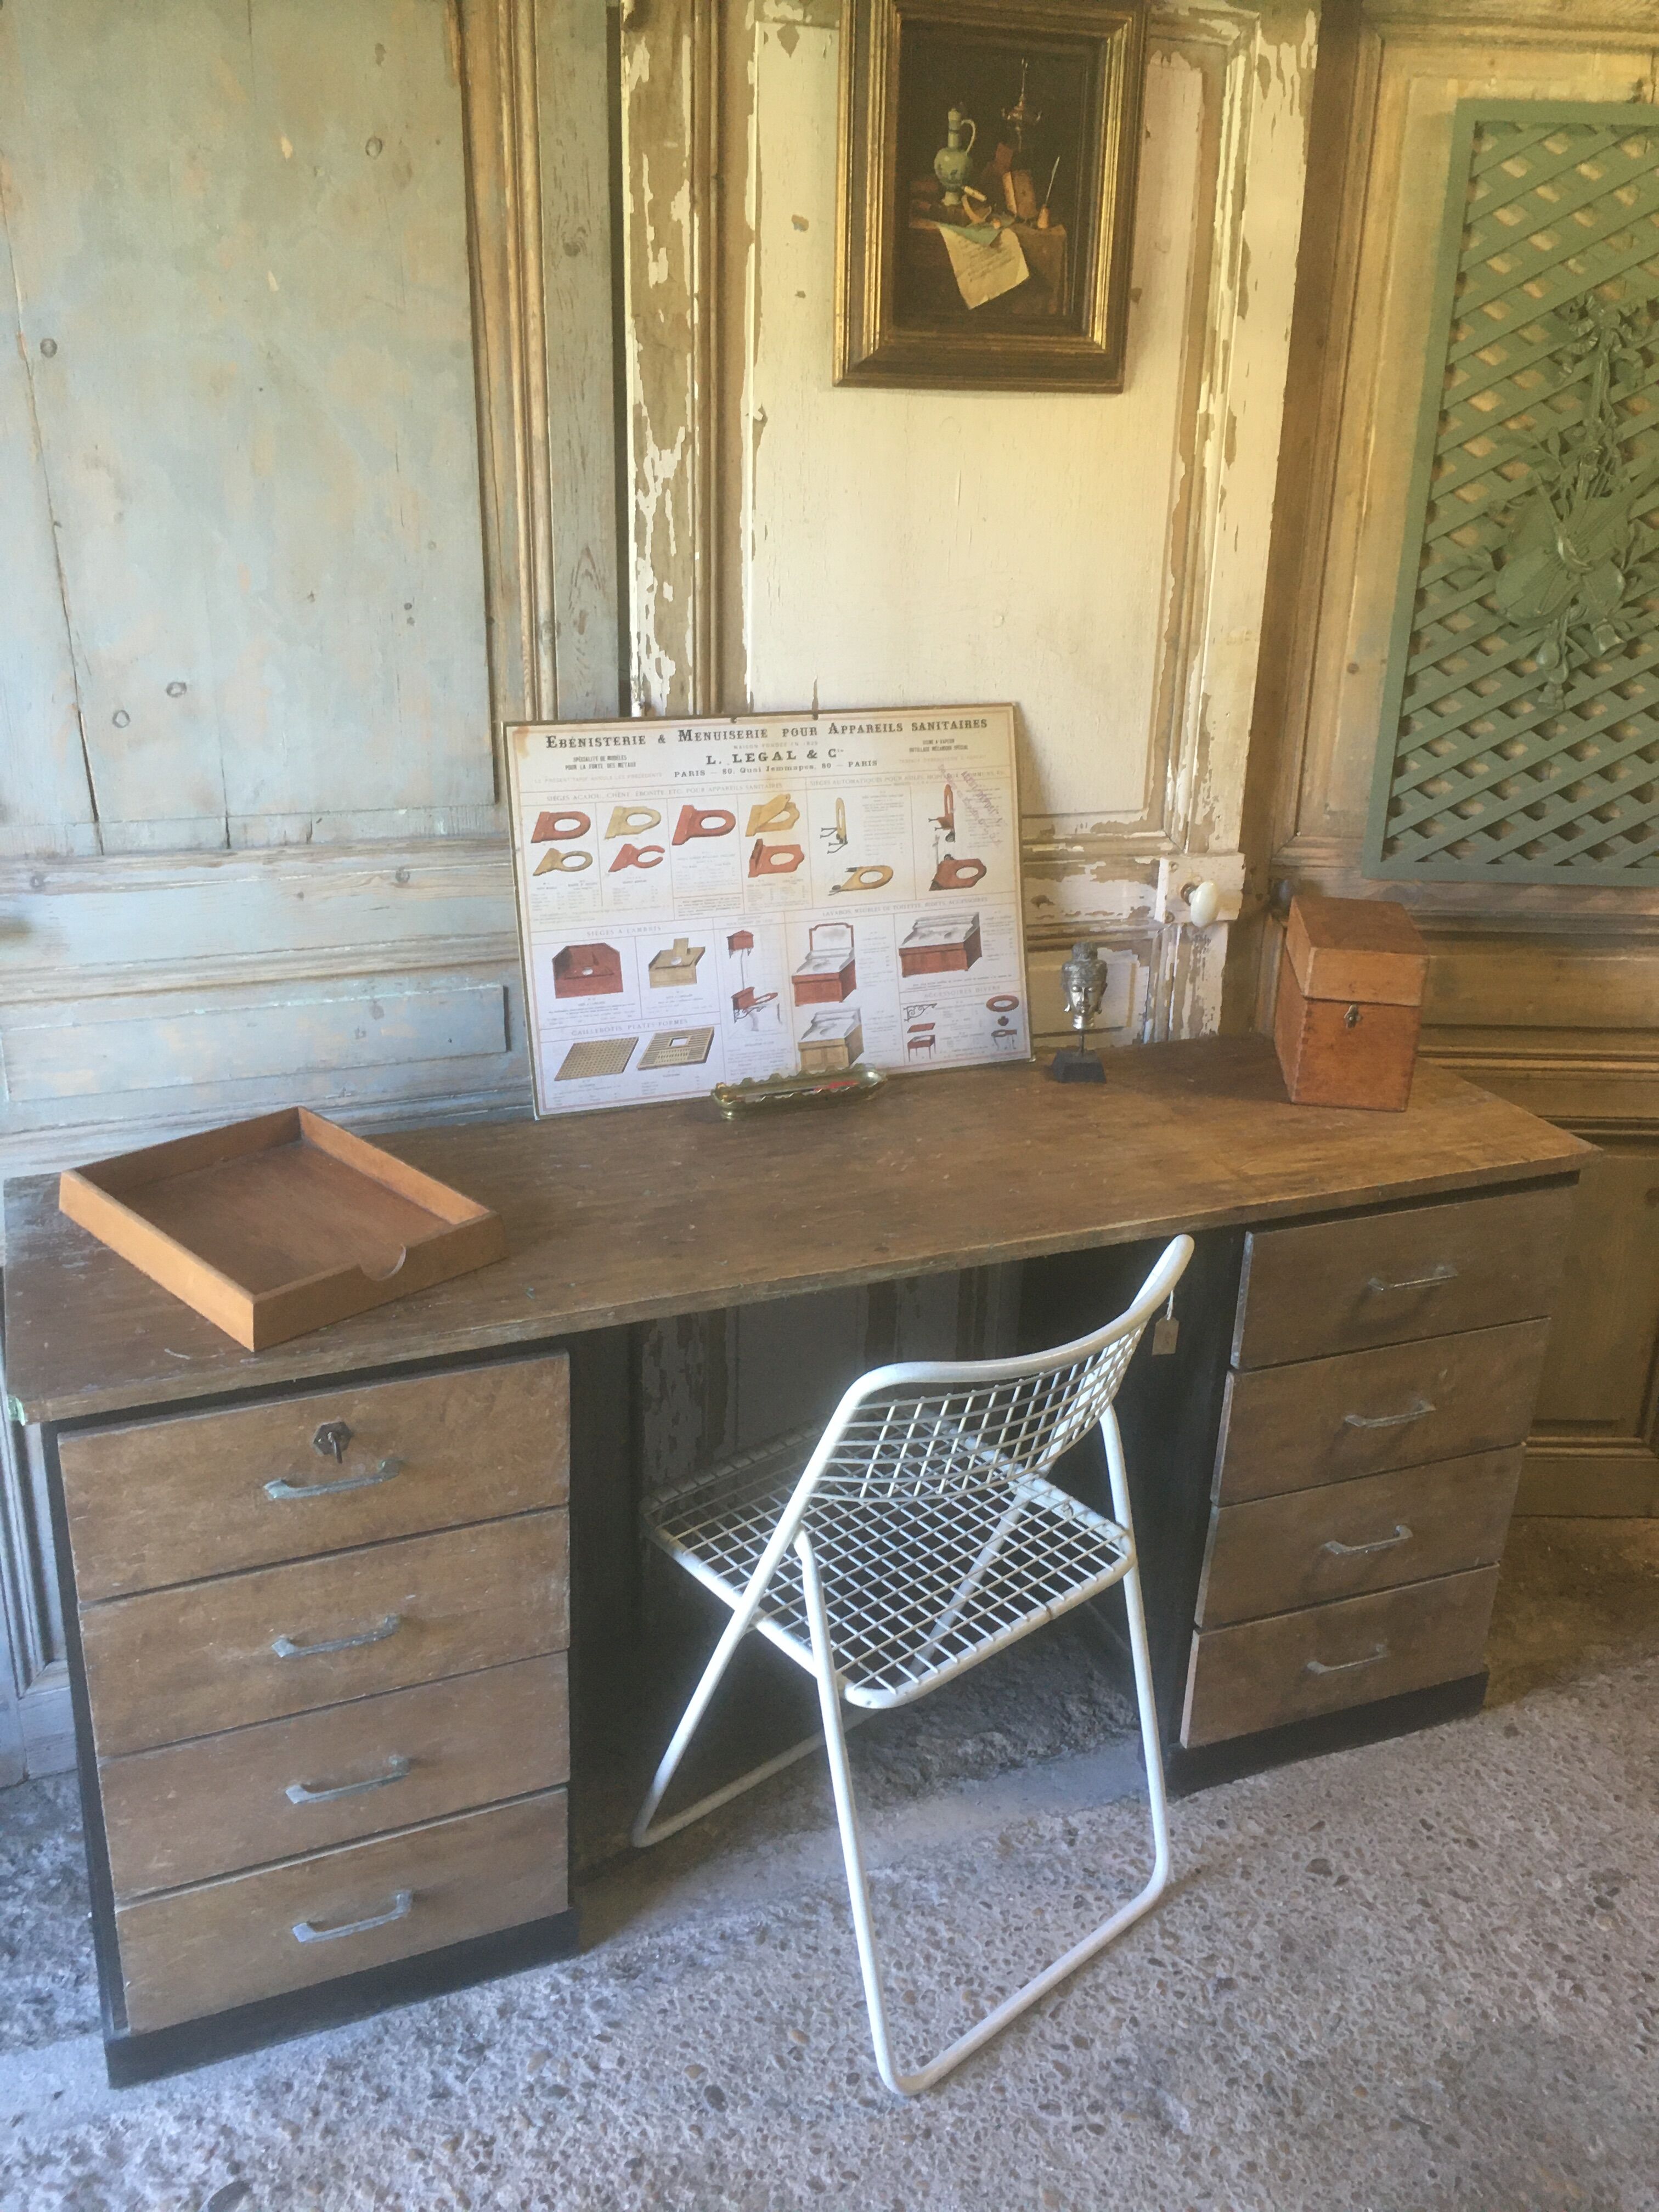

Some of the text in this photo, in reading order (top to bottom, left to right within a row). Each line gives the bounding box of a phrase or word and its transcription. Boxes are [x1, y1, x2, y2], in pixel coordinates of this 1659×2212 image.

[658, 733, 666, 744] &
[678, 729, 768, 743] MENUISERIE
[782, 726, 818, 738] POUR
[828, 722, 903, 735] APPAREILS
[911, 719, 988, 732] SANITAIRES
[706, 755, 722, 765] L.
[731, 750, 797, 764] LEGAL
[806, 749, 818, 759] &
[674, 770, 706, 778] PARIS
[848, 760, 878, 768] PARIS
